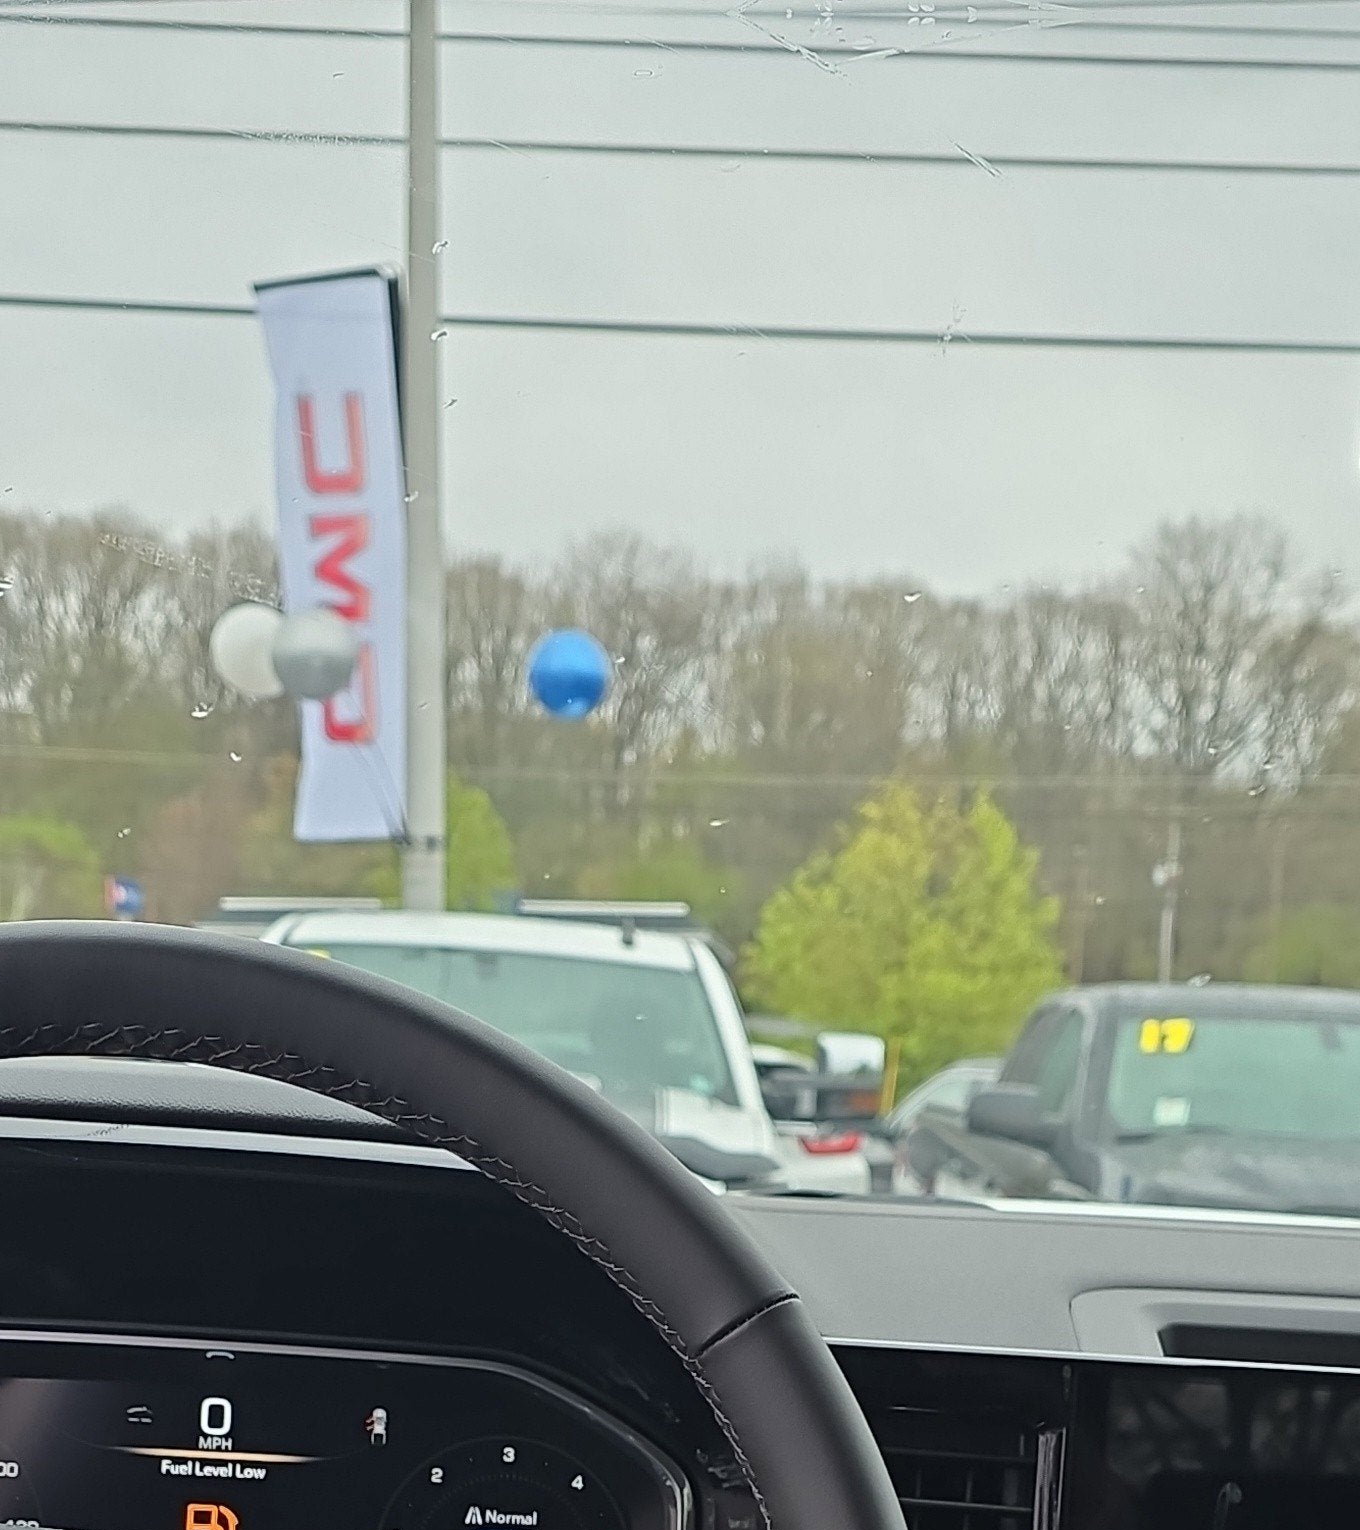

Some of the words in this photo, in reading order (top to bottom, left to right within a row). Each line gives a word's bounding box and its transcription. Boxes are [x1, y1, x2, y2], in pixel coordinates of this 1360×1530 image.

[200, 1397, 232, 1435] 0
[198, 1436, 233, 1451] MPH
[502, 1446, 516, 1463] 3
[160, 1459, 193, 1475] Fuel
[194, 1461, 233, 1478] Level
[235, 1464, 267, 1480] Low
[430, 1467, 443, 1483] 2
[571, 1475, 585, 1490] 4
[485, 1509, 538, 1526] Normal
